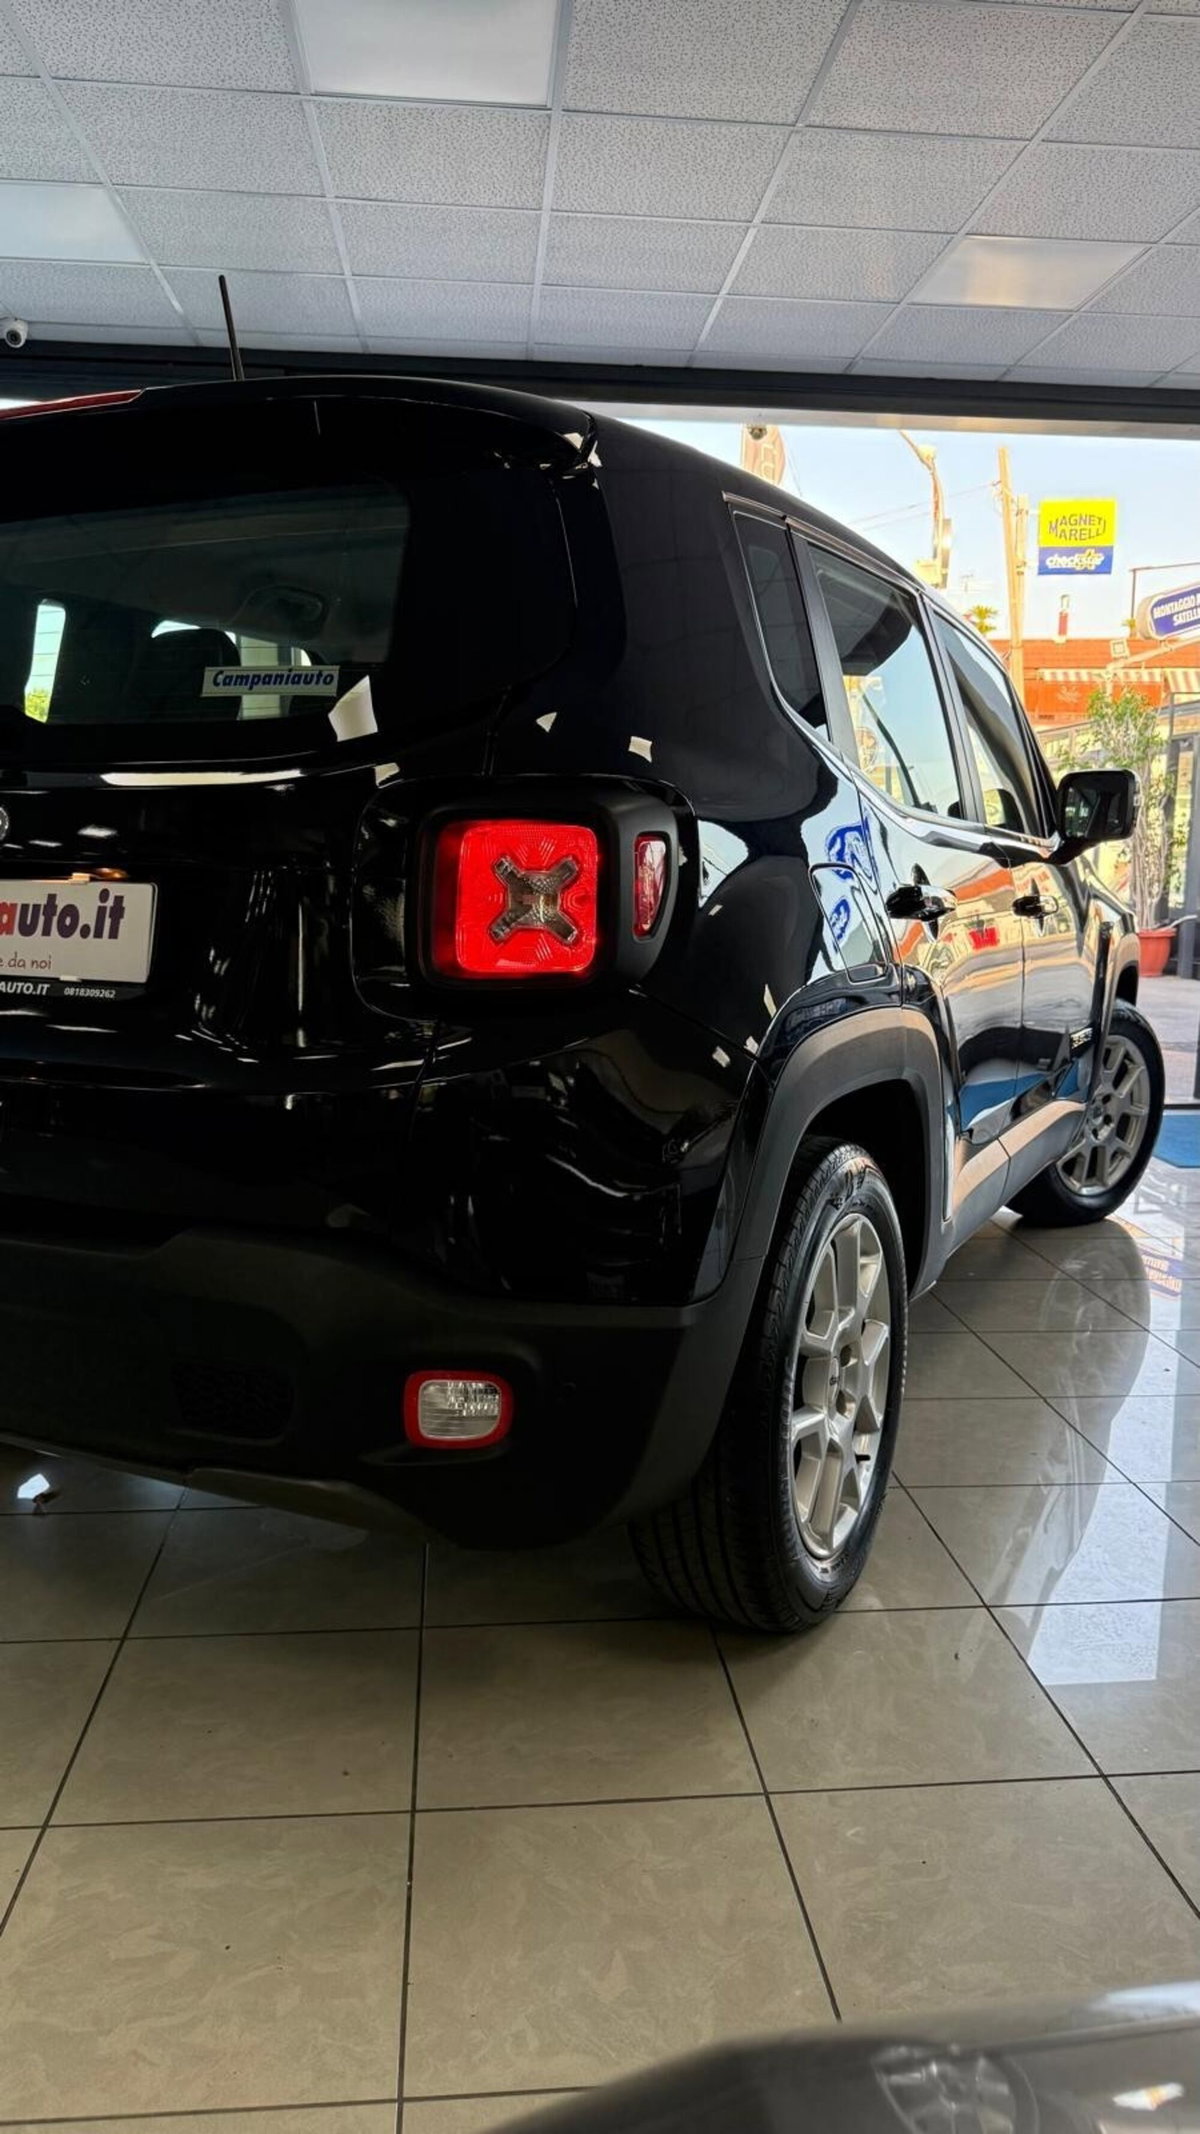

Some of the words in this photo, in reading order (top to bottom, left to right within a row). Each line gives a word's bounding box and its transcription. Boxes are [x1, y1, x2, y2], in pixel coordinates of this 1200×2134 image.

[213, 668, 334, 691] Campaniauto
[8, 951, 26, 969] da
[31, 954, 52, 970] noi
